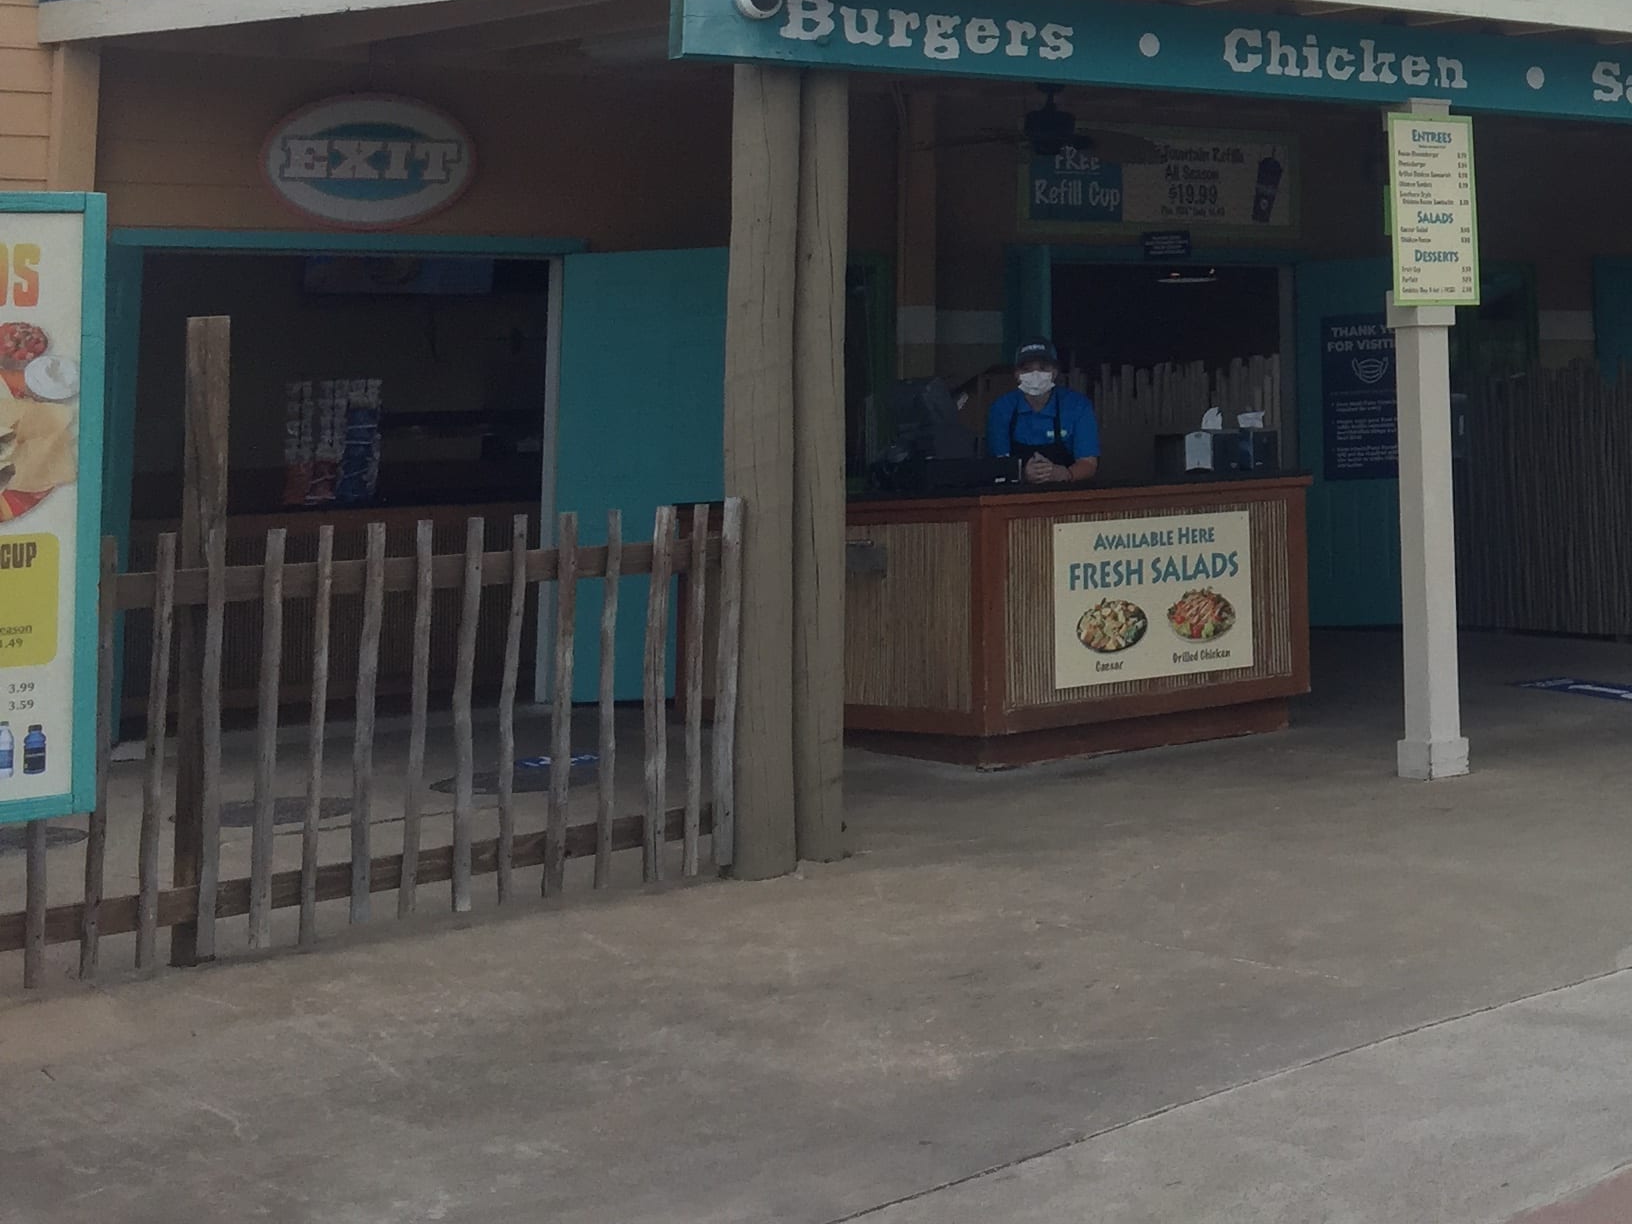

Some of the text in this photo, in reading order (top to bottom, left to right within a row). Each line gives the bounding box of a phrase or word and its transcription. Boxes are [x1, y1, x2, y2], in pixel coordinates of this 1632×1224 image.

[1223, 26, 1469, 88] Chicken
[1412, 129, 1452, 144] ENTREES
[279, 137, 463, 180] EXIT
[1035, 179, 1121, 212] Refill Cup
[1168, 184, 1218, 205] $19.99
[1417, 211, 1453, 225] SALADS
[1414, 249, 1459, 263] DESSERTS
[1331, 324, 1377, 338] THANK
[1327, 339, 1354, 353] FOR
[1094, 526, 1215, 551] AVAILABLE HERE
[0, 542, 37, 569] CUP
[1069, 550, 1239, 591] FRESH SALADS
[1200, 648, 1231, 661] Chicken
[1096, 660, 1124, 673] Caesar
[8, 682, 35, 695] 3.99
[8, 699, 35, 711] 3.59
